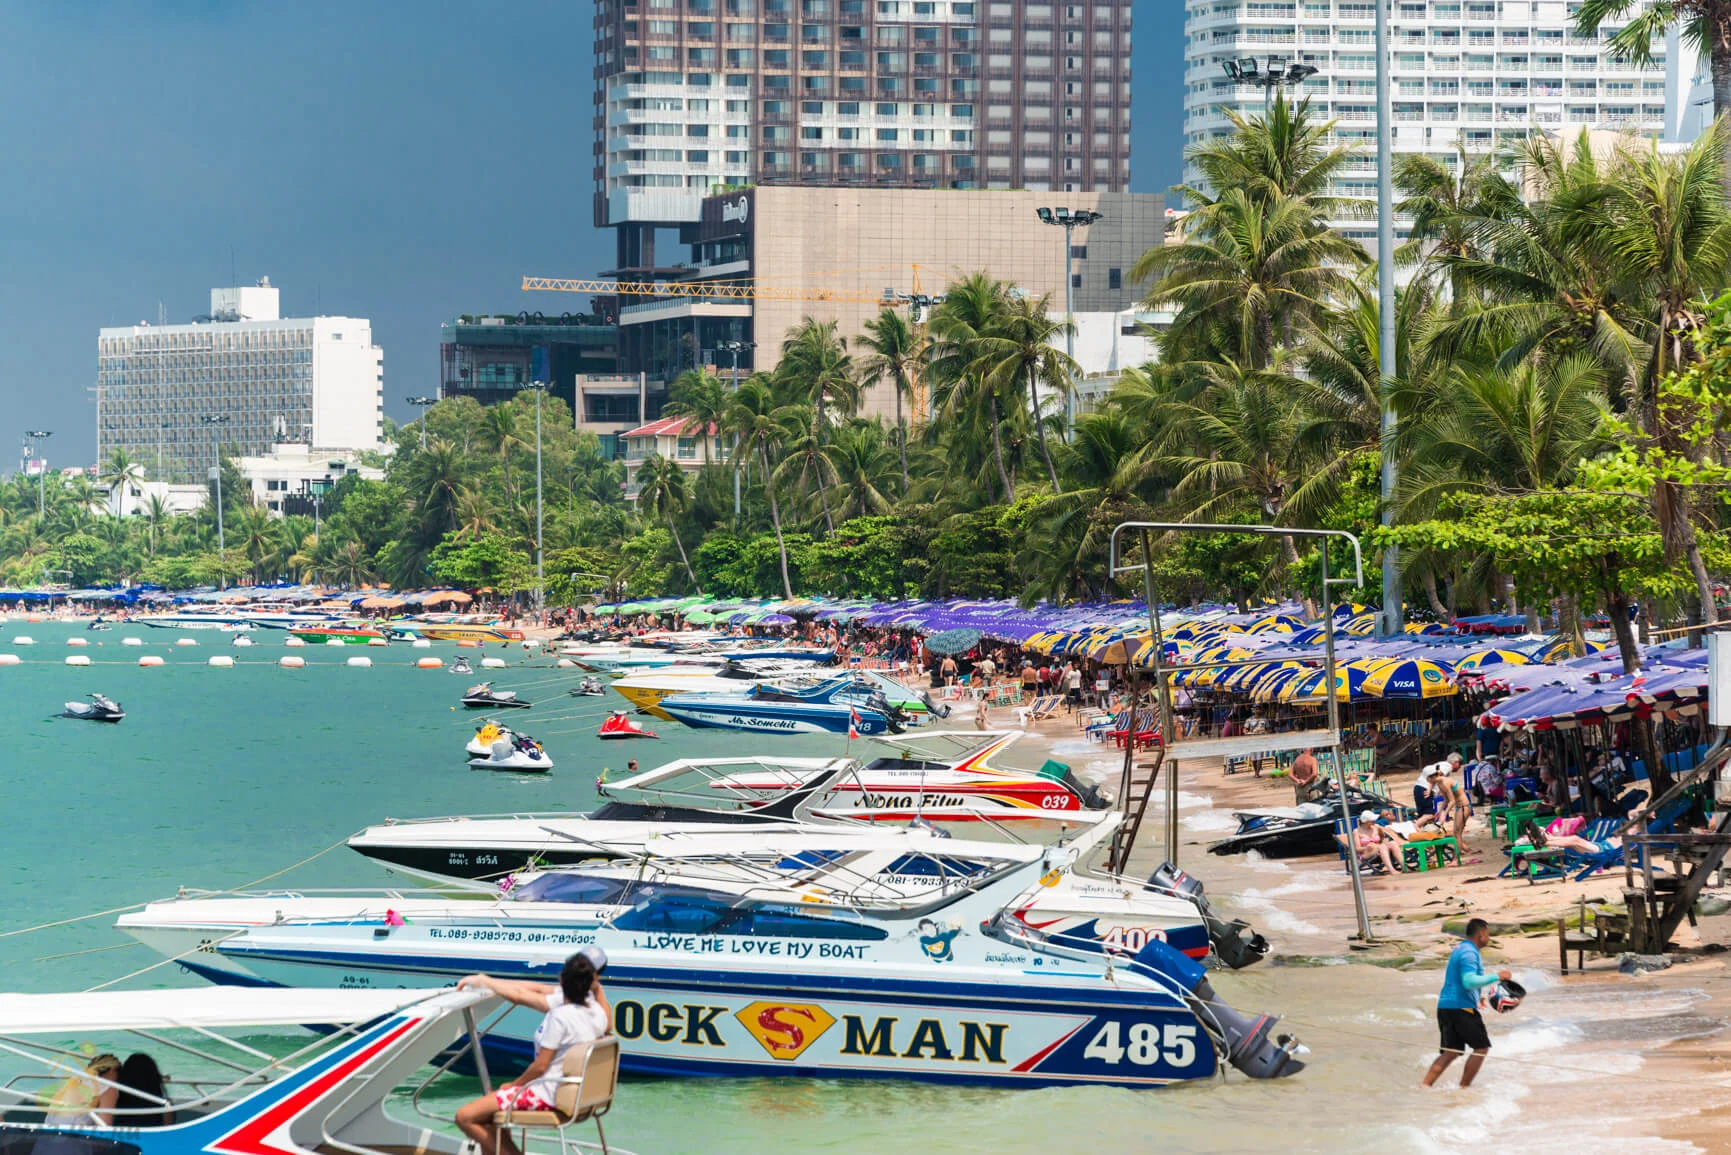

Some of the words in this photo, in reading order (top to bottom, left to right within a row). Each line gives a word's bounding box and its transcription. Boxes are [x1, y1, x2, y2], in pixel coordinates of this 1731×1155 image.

[1042, 795, 1070, 809] 039
[647, 936, 696, 950] LOVE
[701, 938, 724, 953] ME
[732, 940, 782, 955] LOVE
[787, 942, 813, 959] MY
[819, 944, 871, 959] BOAT
[838, 1014, 1010, 1065] MAN
[1083, 1021, 1197, 1067] 485
